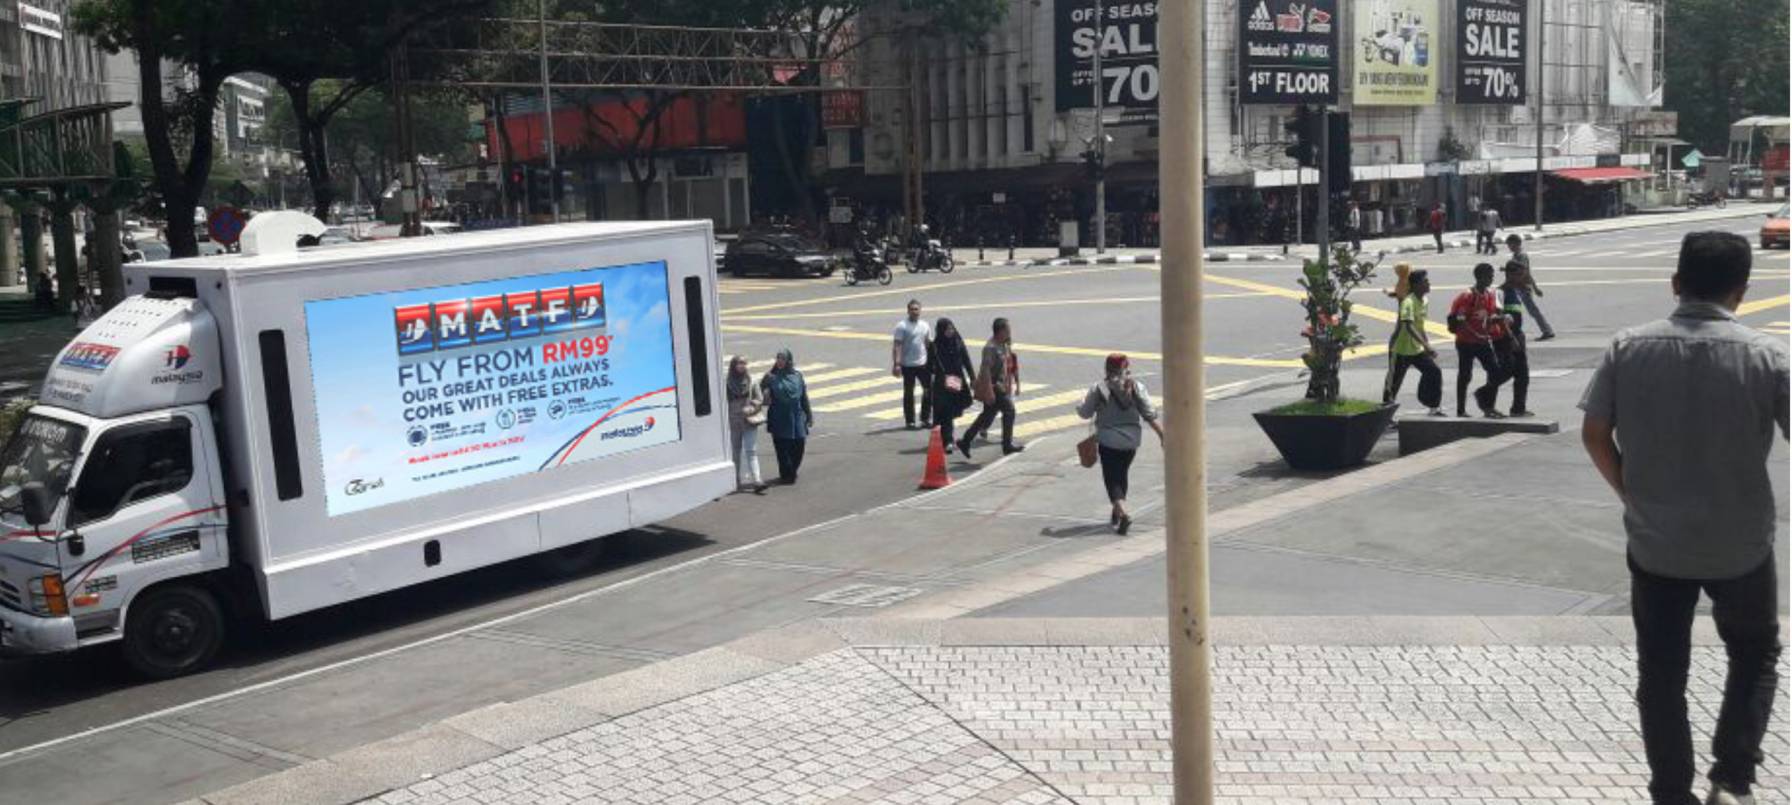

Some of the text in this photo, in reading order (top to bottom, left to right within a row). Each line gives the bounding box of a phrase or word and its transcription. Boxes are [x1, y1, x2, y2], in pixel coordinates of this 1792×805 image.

[1108, 2, 1159, 19] SEAS
[1465, 7, 1520, 24] OFF SEASON
[1072, 24, 1159, 58] SAL
[1465, 23, 1520, 58] SALE
[1276, 72, 1329, 94] FLOOR
[1483, 67, 1518, 97] 70%
[399, 360, 447, 387] FLY
[457, 347, 533, 377] FROM
[402, 359, 610, 404] OUR GREAT DEALS ALWAYS
[403, 375, 614, 421] COME WITH FREE EXTRAS.
